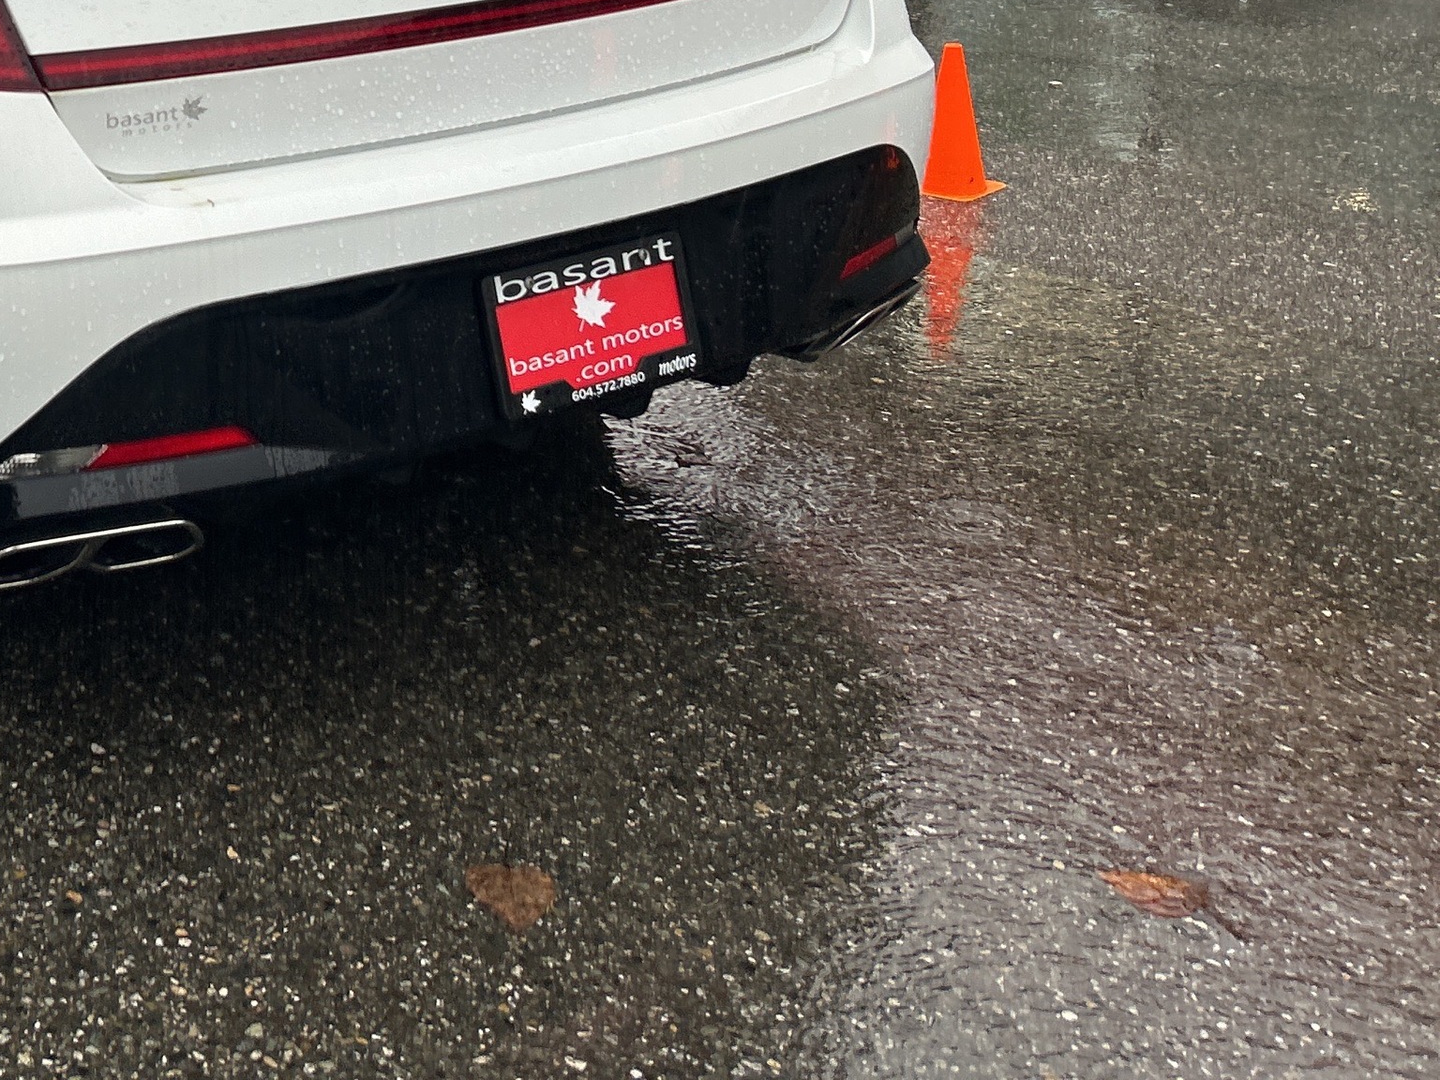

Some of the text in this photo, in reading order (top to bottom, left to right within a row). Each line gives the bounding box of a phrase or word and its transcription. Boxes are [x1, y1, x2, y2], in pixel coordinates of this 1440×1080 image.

[106, 107, 178, 129] basant
[122, 122, 193, 137] motors
[494, 238, 675, 304] basant
[509, 315, 684, 377] basant motors
[571, 353, 697, 402] 604.572.7880 motors
[575, 354, 633, 383] .com
